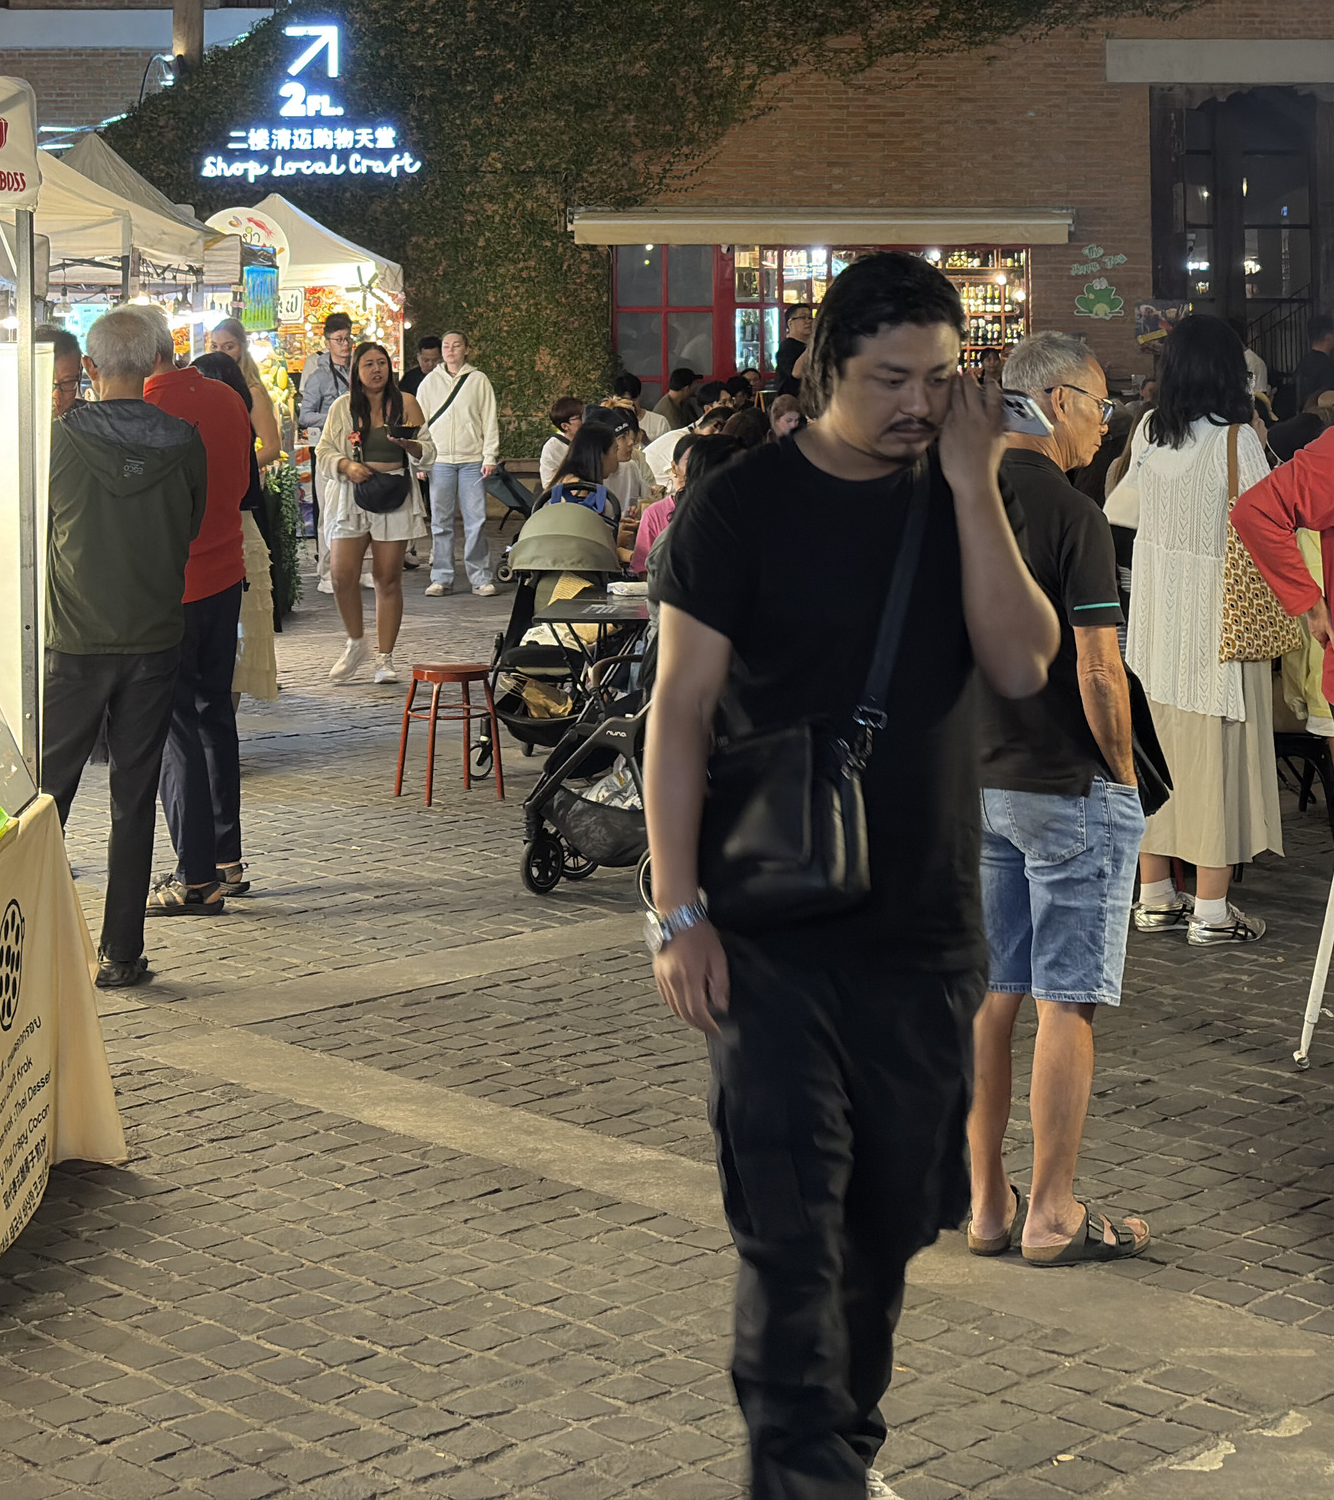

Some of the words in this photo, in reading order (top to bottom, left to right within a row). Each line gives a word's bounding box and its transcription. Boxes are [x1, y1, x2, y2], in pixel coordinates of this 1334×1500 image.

[227, 126, 397, 151] 二楼清迈购物天堂
[201, 156, 269, 183] Shop
[272, 155, 346, 177] Local
[349, 151, 422, 178] Craft
[17, 1055, 33, 1081] Krok
[28, 1068, 51, 1102] Desser
[3, 1150, 14, 1175] Thai
[13, 1128, 29, 1159] Crispy
[28, 1103, 50, 1135] Cocon
